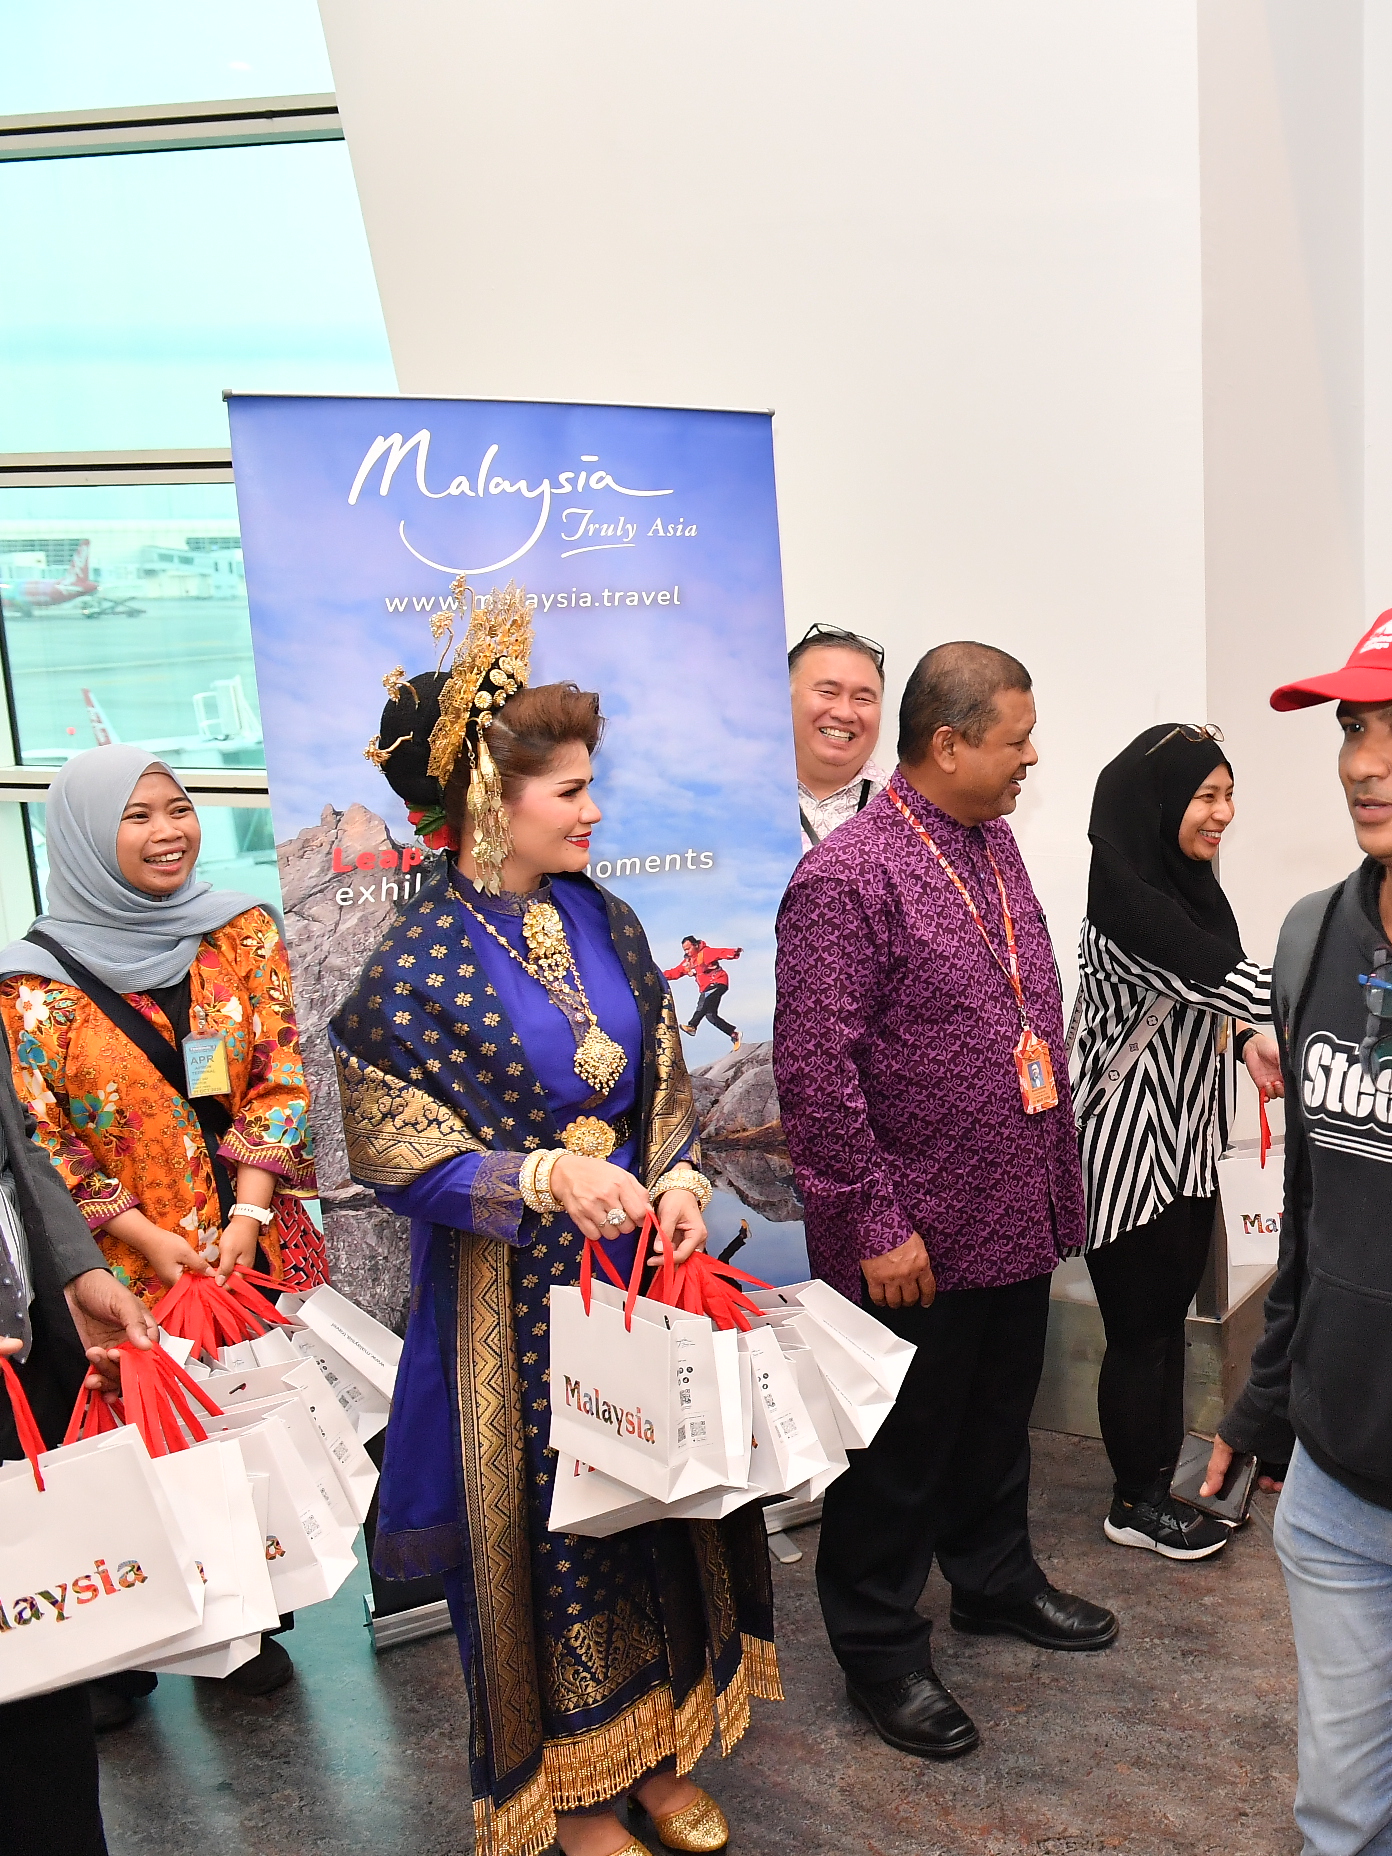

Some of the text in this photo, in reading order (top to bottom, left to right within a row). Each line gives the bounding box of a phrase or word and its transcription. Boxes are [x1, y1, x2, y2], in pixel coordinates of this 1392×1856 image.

[348, 428, 675, 575] Malaysia
[561, 507, 698, 542] Truly Asia
[332, 847, 423, 873] Leap
[563, 1374, 655, 1444] Malaysia
